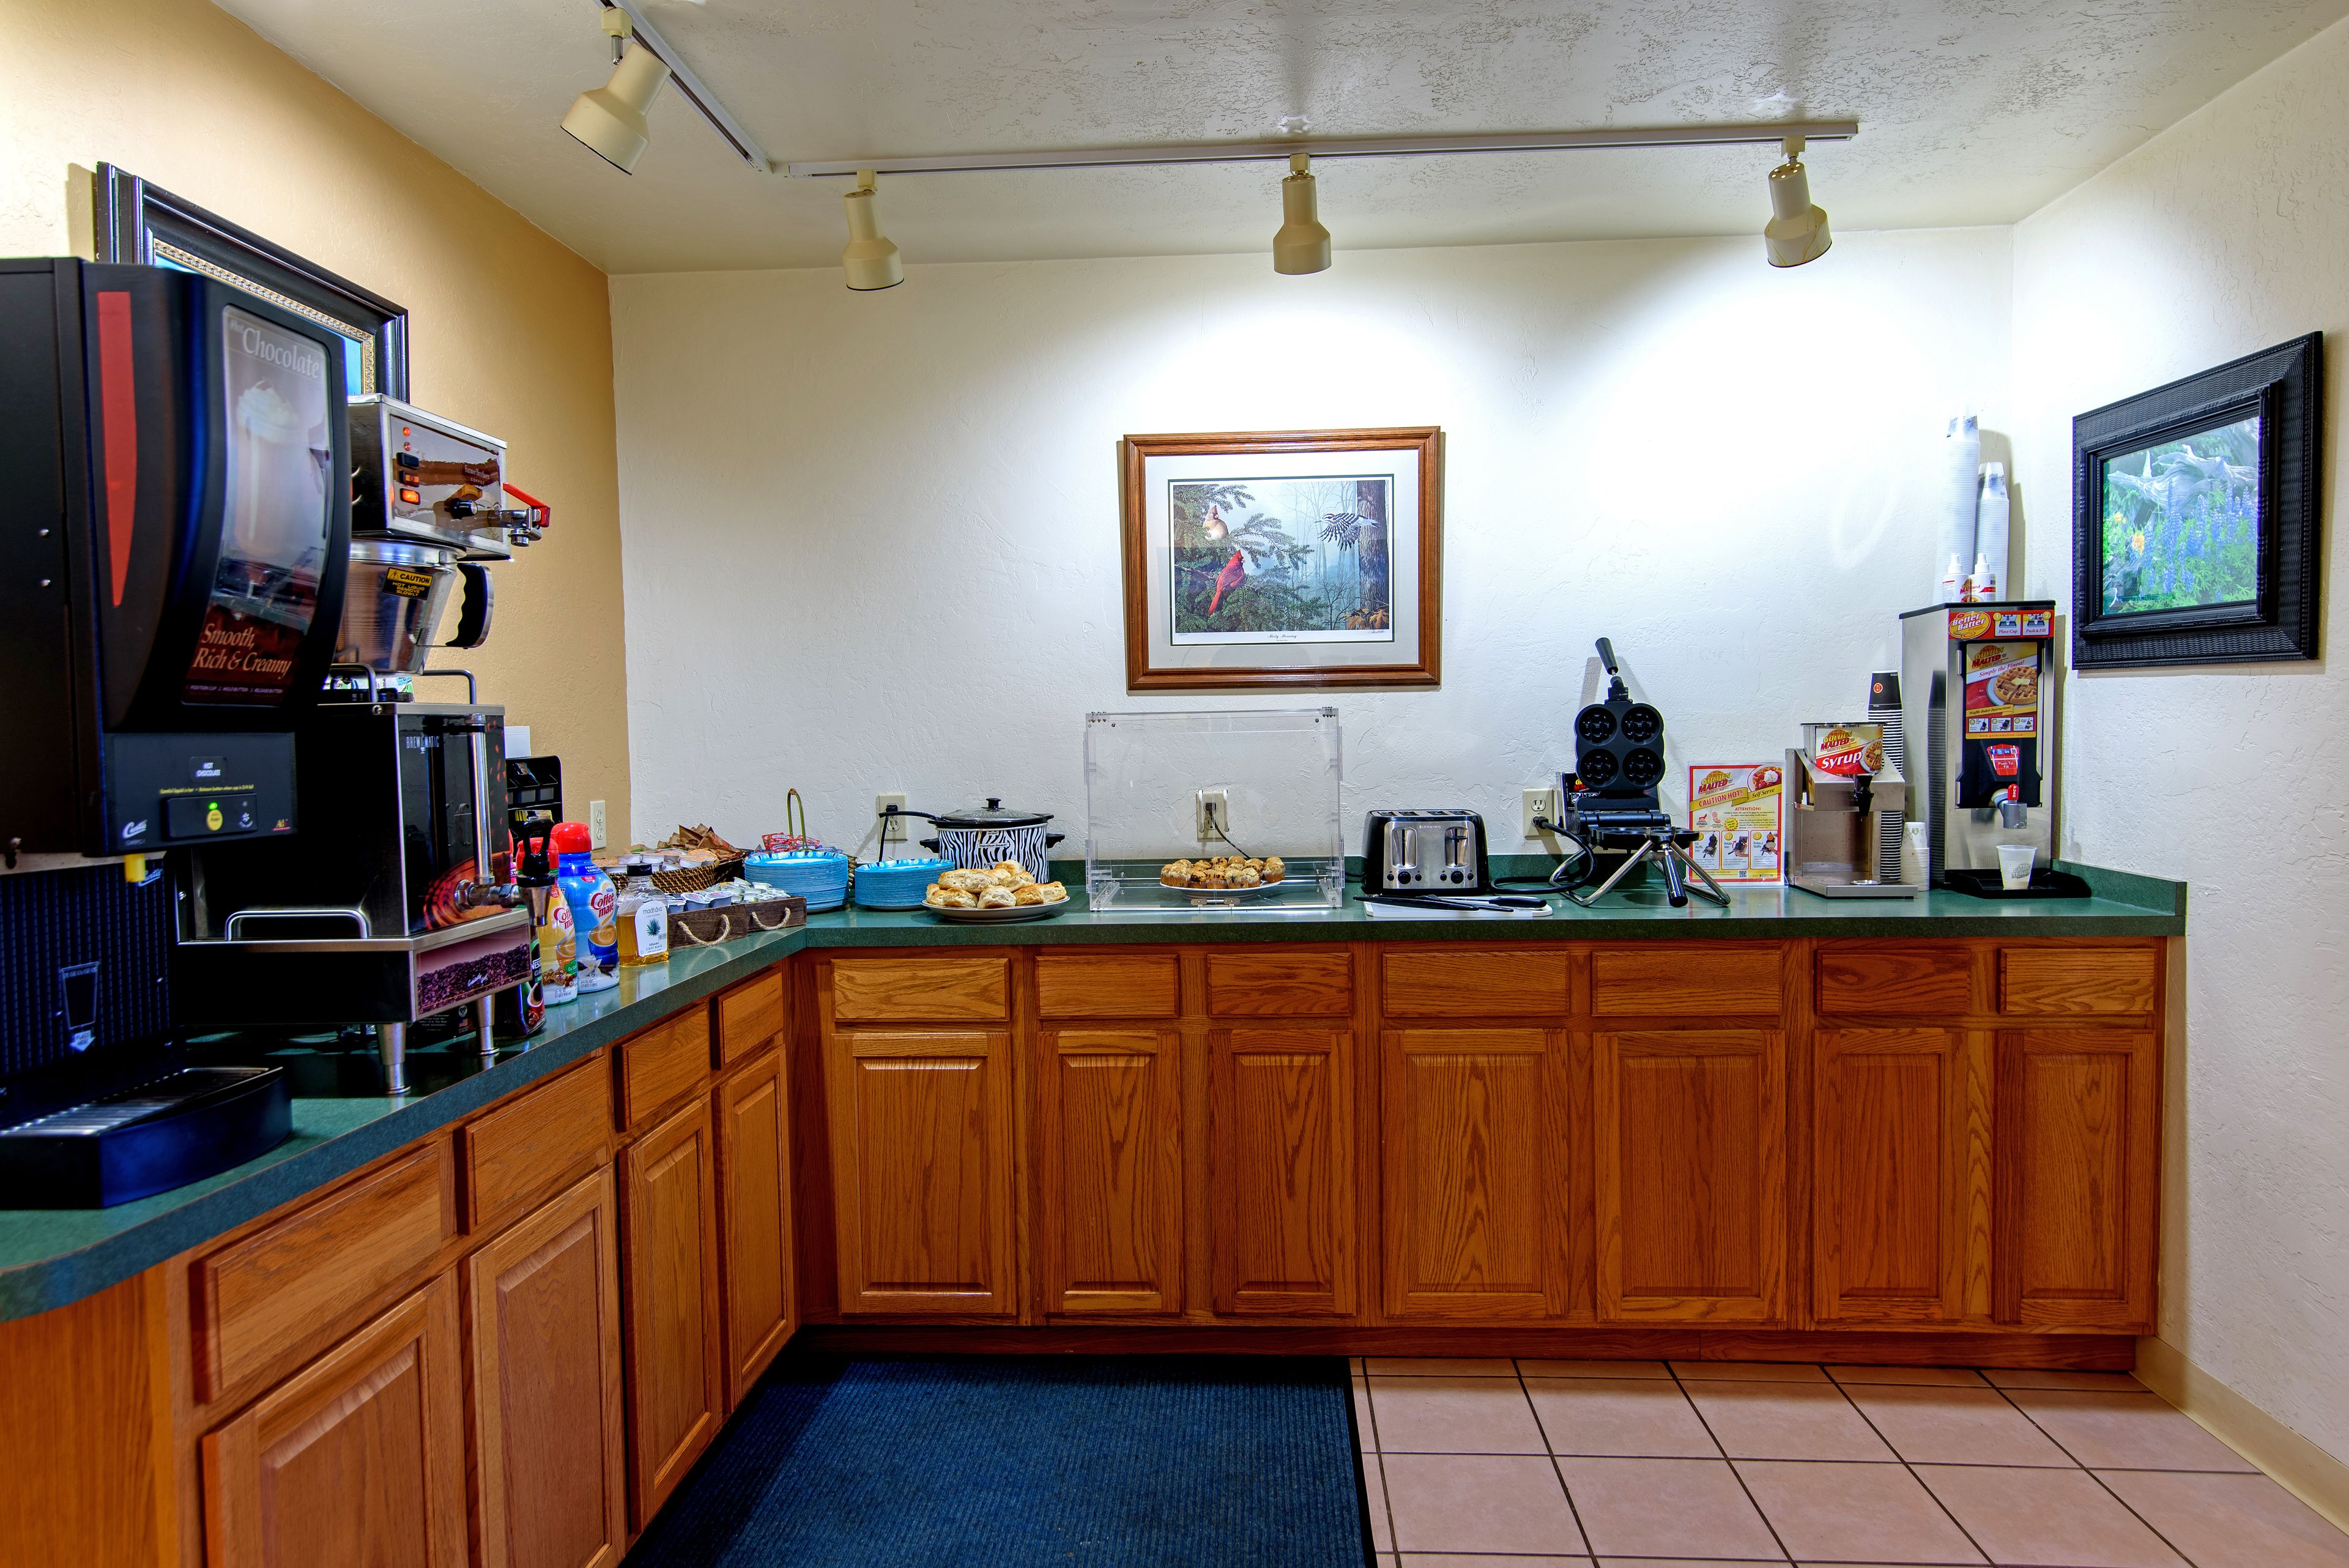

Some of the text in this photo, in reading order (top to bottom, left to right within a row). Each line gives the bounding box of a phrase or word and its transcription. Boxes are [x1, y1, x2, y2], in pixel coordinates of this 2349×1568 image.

[243, 327, 319, 379] Chocolate
[400, 573, 430, 584] CAUTION
[1951, 613, 1981, 626] Better
[1957, 618, 1986, 631] Batter
[201, 623, 256, 650] Smooth,
[1975, 646, 2005, 660] GOLDEN
[193, 648, 292, 680] Rich & Creamy
[1972, 655, 2002, 667] MALTED
[1979, 668, 1997, 677] Simply
[2007, 660, 2025, 669] Finest!
[1820, 738, 1850, 750] MALTED
[1823, 731, 1852, 743] GOLDEN
[1821, 752, 1863, 769] Syrup
[1698, 779, 1728, 793] MALTED
[1701, 772, 1731, 786] GOLDEN
[1699, 789, 1743, 807] CAUTION HOT!
[590, 891, 614, 910] Coffee
[554, 907, 572, 923] Coff
[598, 903, 614, 918] mate
[643, 906, 662, 915] madhāva
[564, 919, 574, 930] ma
